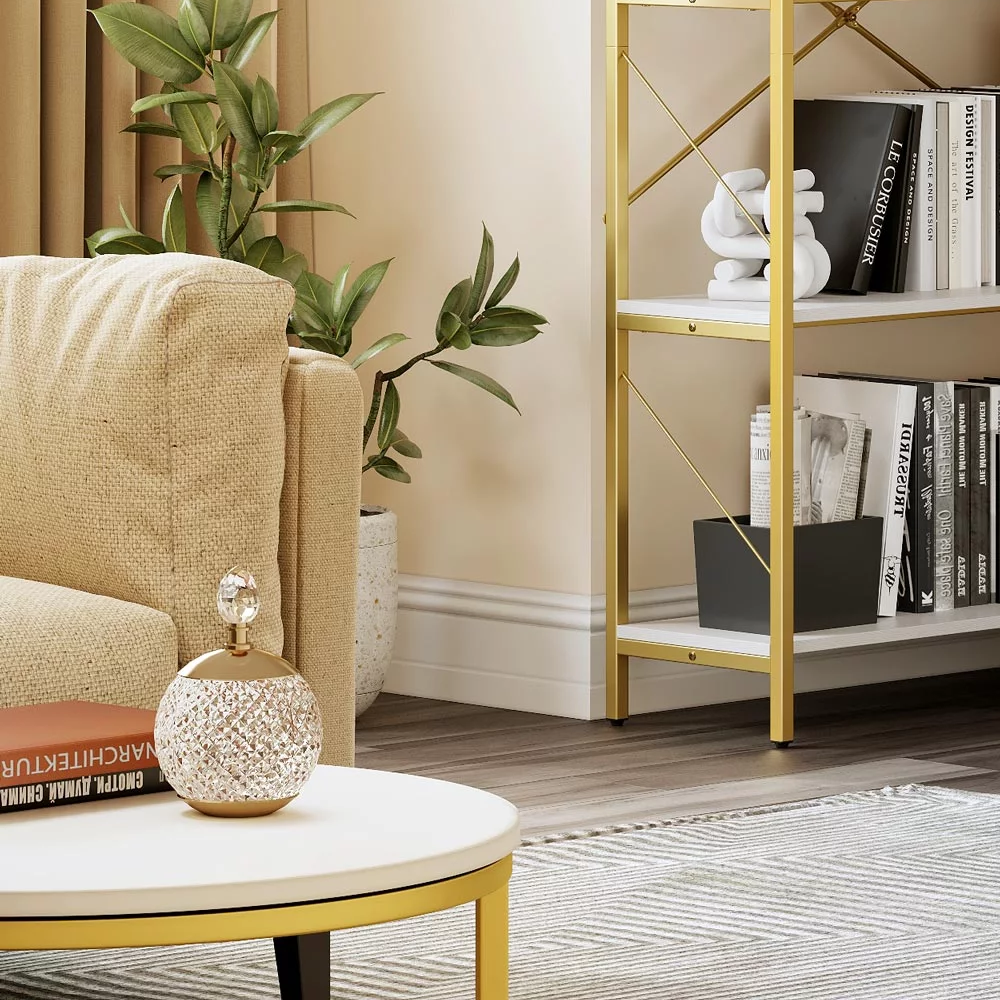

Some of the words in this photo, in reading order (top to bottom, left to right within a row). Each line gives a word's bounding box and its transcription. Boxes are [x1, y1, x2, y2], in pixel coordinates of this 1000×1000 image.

[966, 105, 974, 146] DESIGN
[888, 140, 903, 163] LE
[951, 182, 959, 194] of
[966, 151, 974, 200] FESTIVAL
[862, 166, 896, 265] CORBUSIER
[46, 776, 92, 803] ДУМАЙ.
[94, 771, 144, 794] СМОТРИ.
